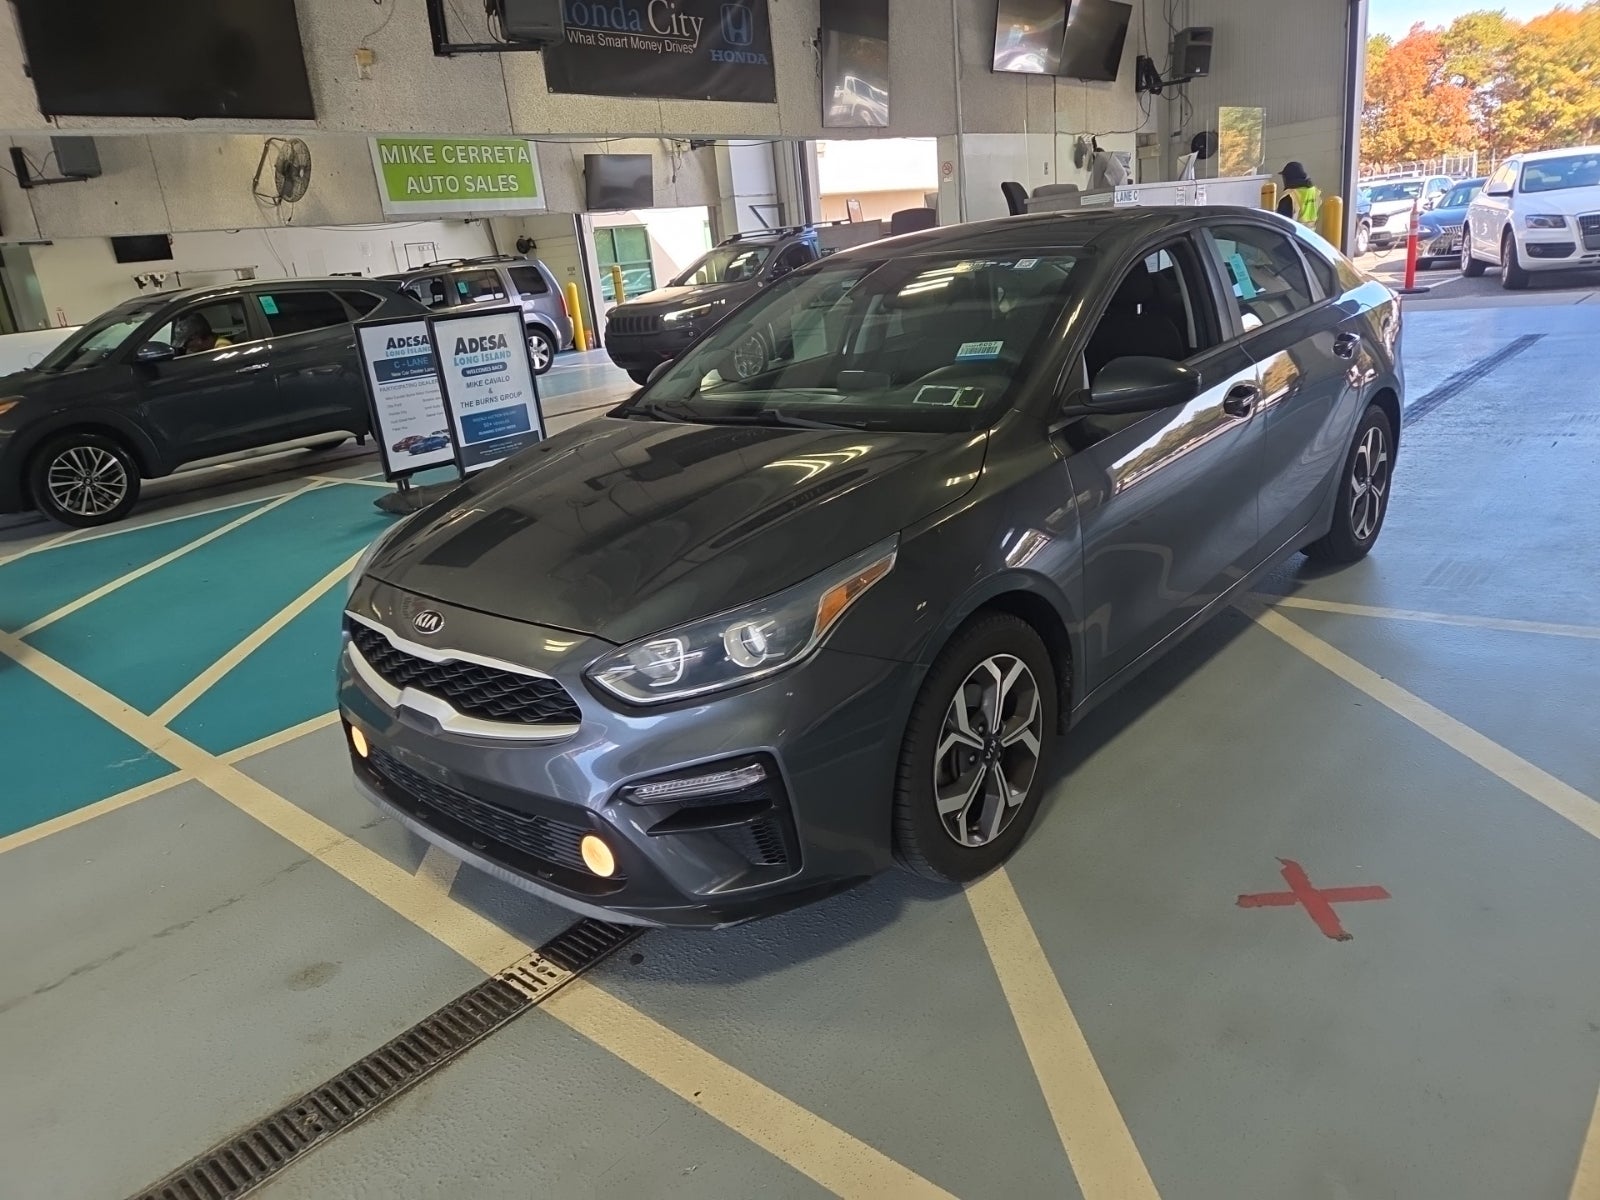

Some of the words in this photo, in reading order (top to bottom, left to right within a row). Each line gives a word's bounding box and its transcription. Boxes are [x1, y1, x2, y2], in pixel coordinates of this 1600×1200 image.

[647, 0, 704, 48] City
[566, 30, 596, 46] What
[598, 33, 628, 48] Smart
[630, 38, 662, 54] Money
[665, 40, 694, 54] Drives
[710, 49, 768, 65] HONDA
[380, 143, 436, 164] MIKE
[441, 145, 530, 164] CERRETA
[406, 175, 460, 194] AUTO
[463, 174, 520, 192] SALES
[1116, 191, 1132, 202] LANE
[1133, 190, 1138, 200] C
[386, 335, 430, 350] ADESA
[455, 334, 508, 356] ADESA
[385, 349, 406, 358] LONG
[453, 355, 480, 367] LONG
[481, 350, 512, 364] ISLAND
[393, 361, 401, 369] C
[406, 357, 429, 367] LANE
[466, 380, 484, 388] MIKE
[484, 375, 510, 386] CAVALO
[460, 400, 474, 409] THE
[475, 396, 499, 406] BURNS
[499, 391, 523, 401] GROUP
[415, 613, 439, 631] KIA
